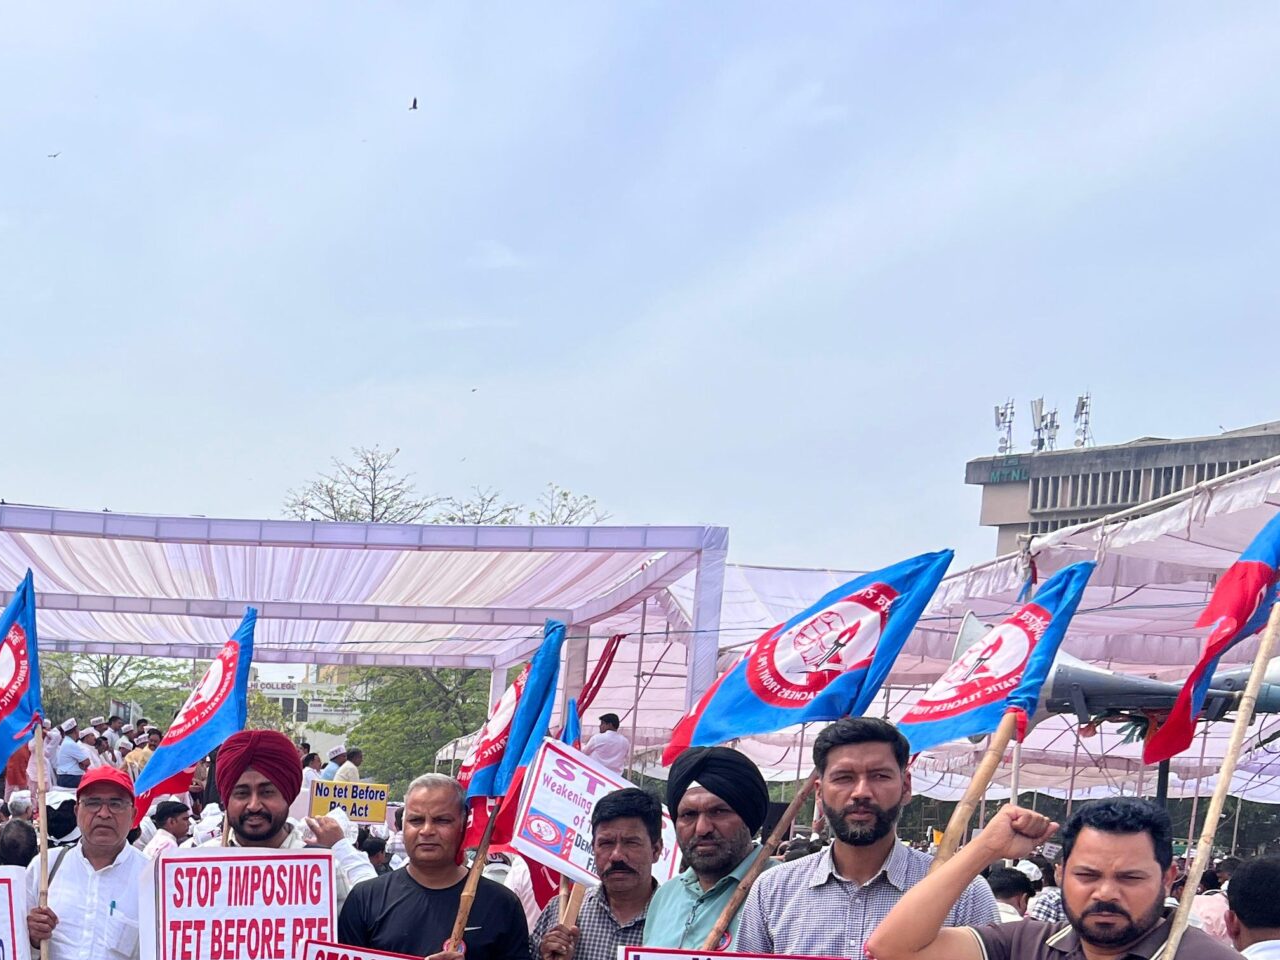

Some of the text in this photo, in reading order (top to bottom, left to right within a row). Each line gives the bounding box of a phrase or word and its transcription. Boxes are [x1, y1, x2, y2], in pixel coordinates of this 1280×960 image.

[315, 782, 386, 801] No tet Before
[542, 772, 593, 814] Weakening
[552, 758, 606, 796] ST
[350, 802, 369, 817] Act
[573, 814, 587, 830] of
[172, 864, 322, 909] STOP IMPOSING
[170, 919, 205, 960] TET
[210, 918, 286, 960] BEFORE
